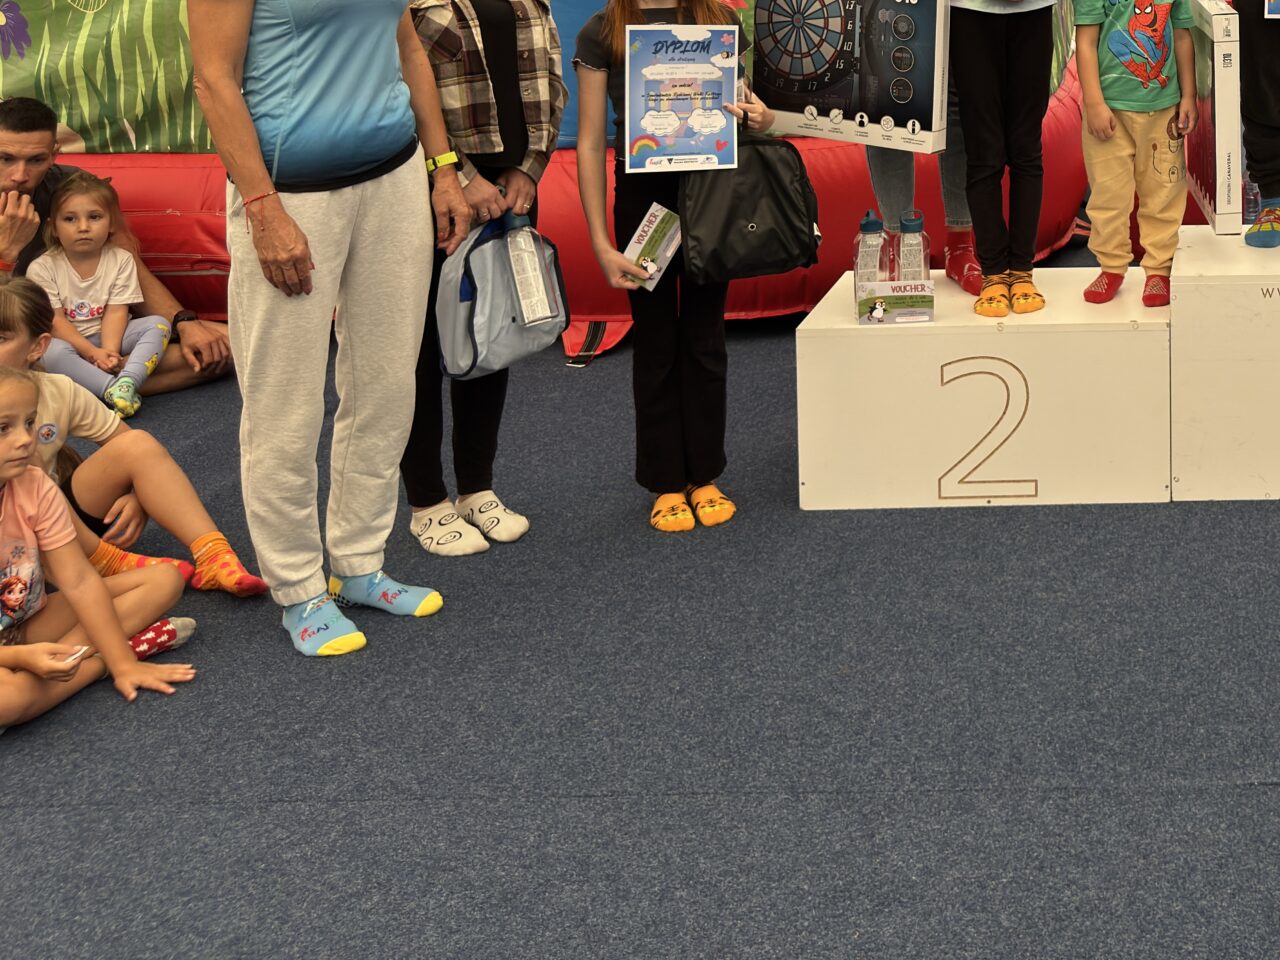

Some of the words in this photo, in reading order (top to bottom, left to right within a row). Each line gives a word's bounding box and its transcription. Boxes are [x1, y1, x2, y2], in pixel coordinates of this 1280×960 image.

[848, 20, 853, 30] 6
[652, 40, 713, 55] DYPLOM
[836, 59, 845, 69] 15
[824, 72, 831, 82] 2
[634, 212, 658, 245] VOUCHER
[891, 283, 927, 294] VOUCHER
[938, 355, 1038, 500] 2
